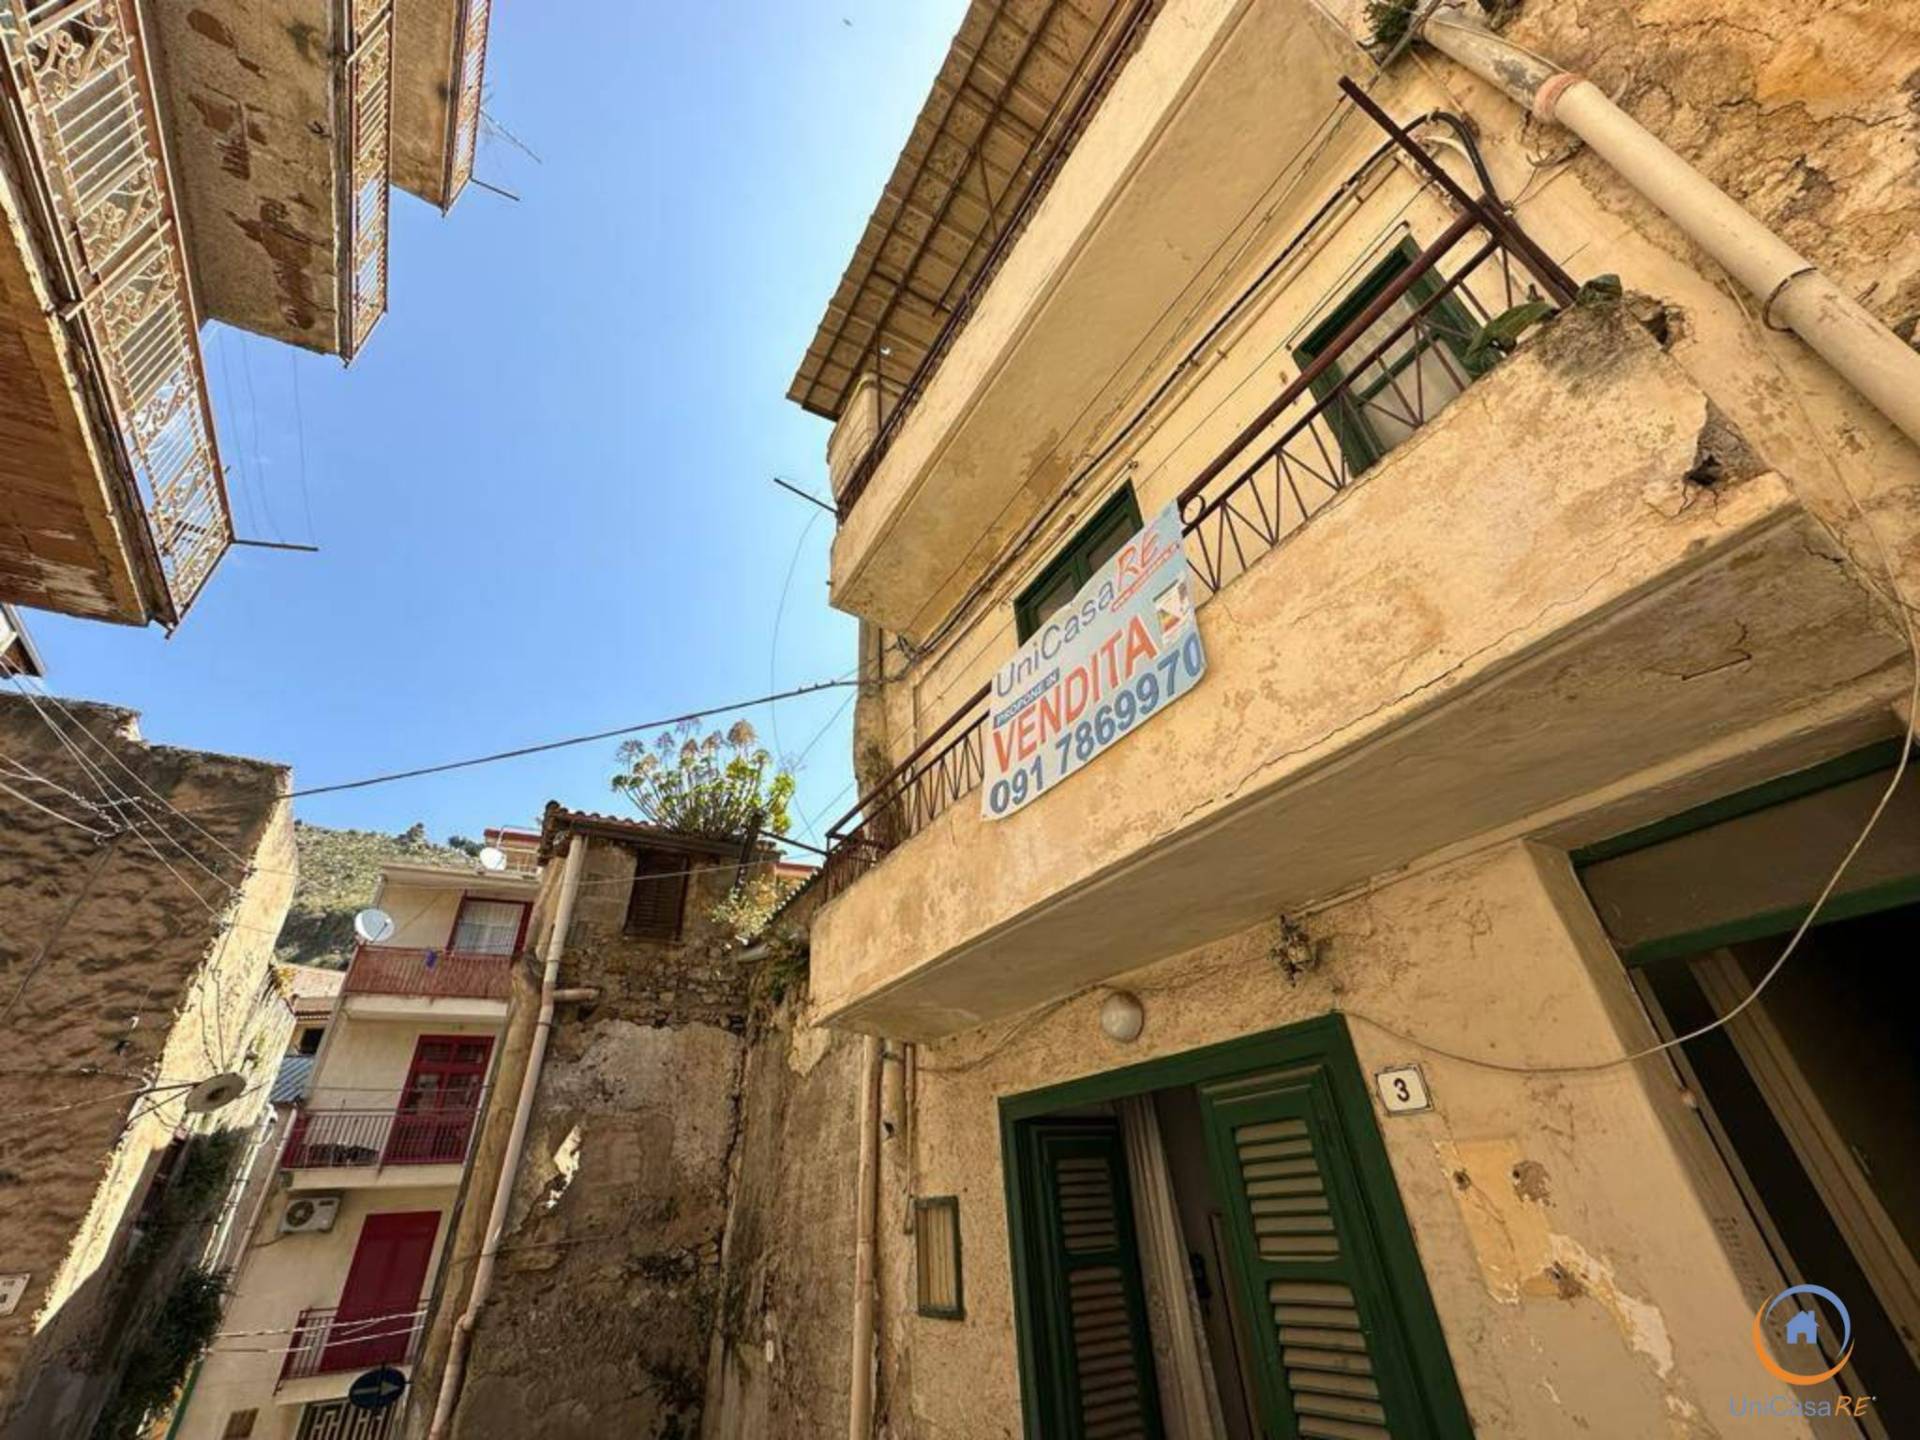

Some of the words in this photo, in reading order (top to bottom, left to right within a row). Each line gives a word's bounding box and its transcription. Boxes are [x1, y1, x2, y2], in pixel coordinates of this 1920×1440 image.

[989, 754, 1044, 814] 091
[1055, 632, 1202, 776] 7869970
[992, 614, 1158, 774] VENDITA
[1393, 1077, 1410, 1102] 3
